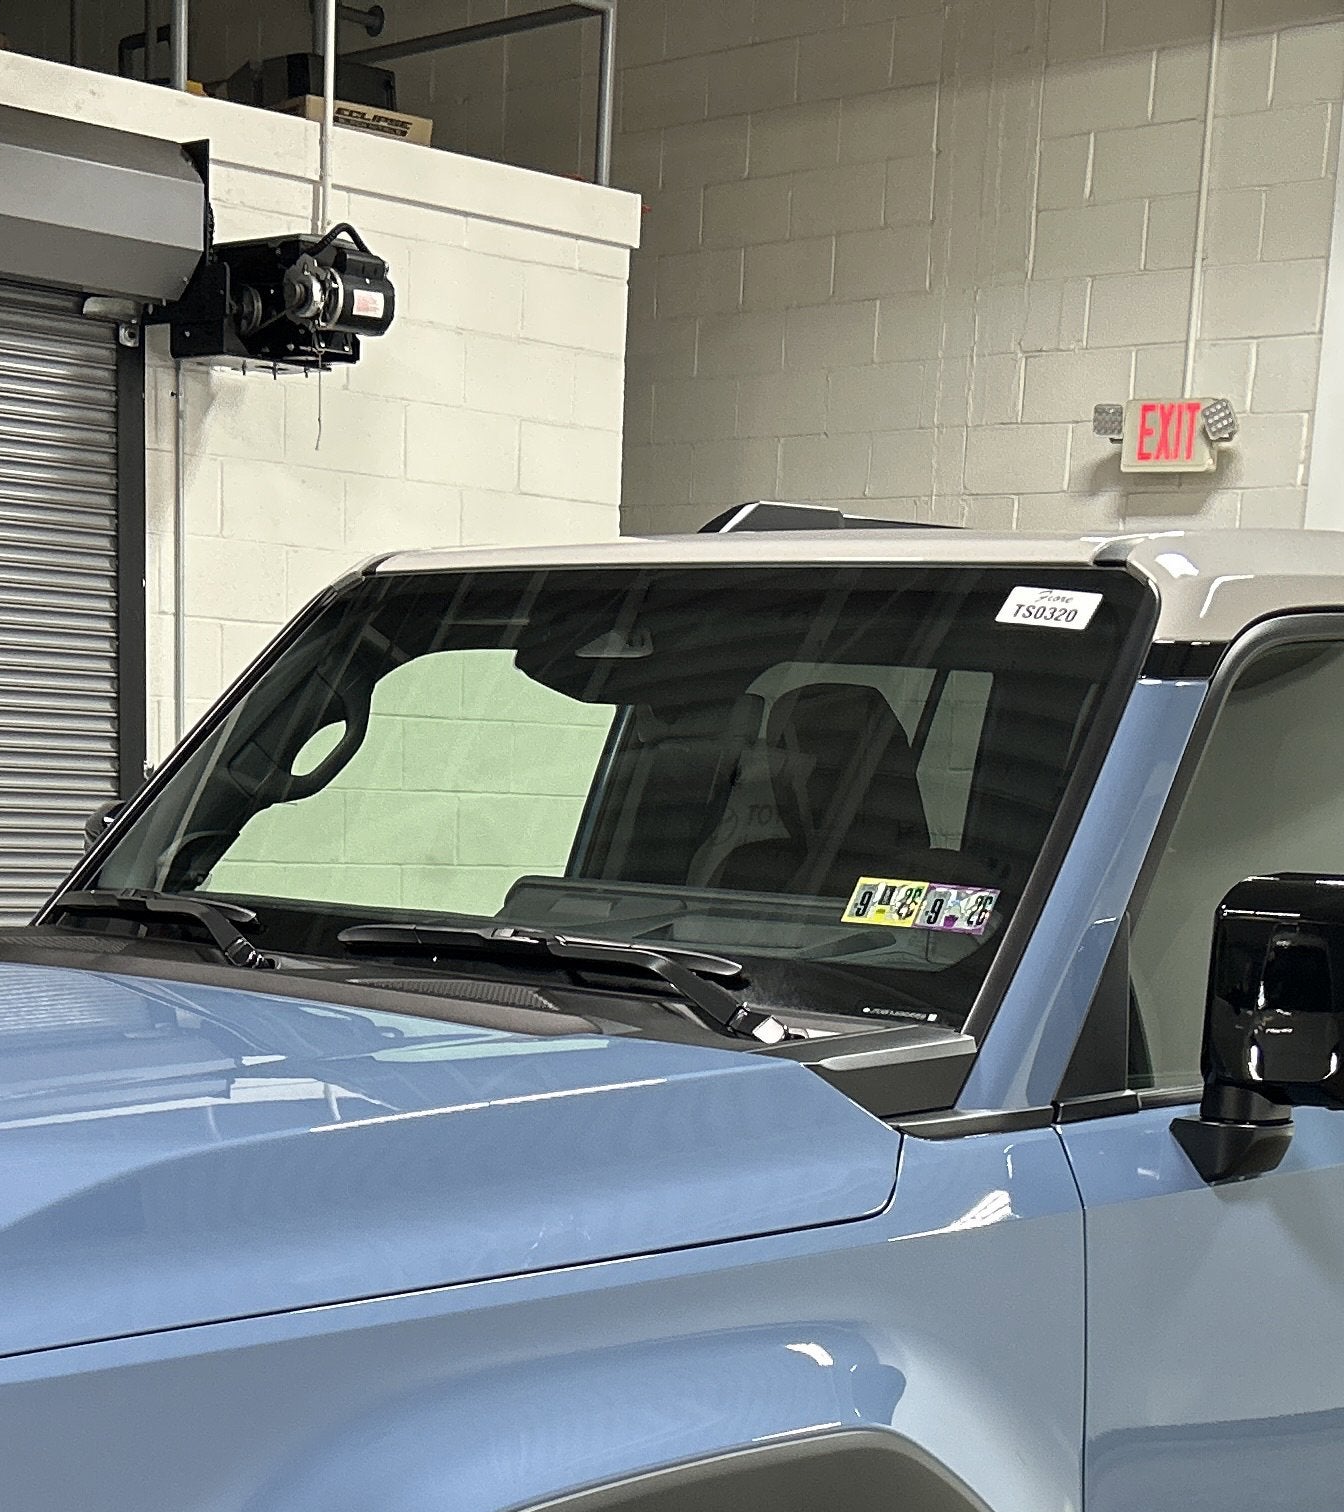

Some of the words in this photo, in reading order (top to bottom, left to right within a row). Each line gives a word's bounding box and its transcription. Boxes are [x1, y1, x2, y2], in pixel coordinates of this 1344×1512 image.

[1136, 401, 1202, 462] EXIT
[1013, 603, 1078, 623] TS0320
[855, 891, 873, 918] 9
[926, 898, 944, 925] 9
